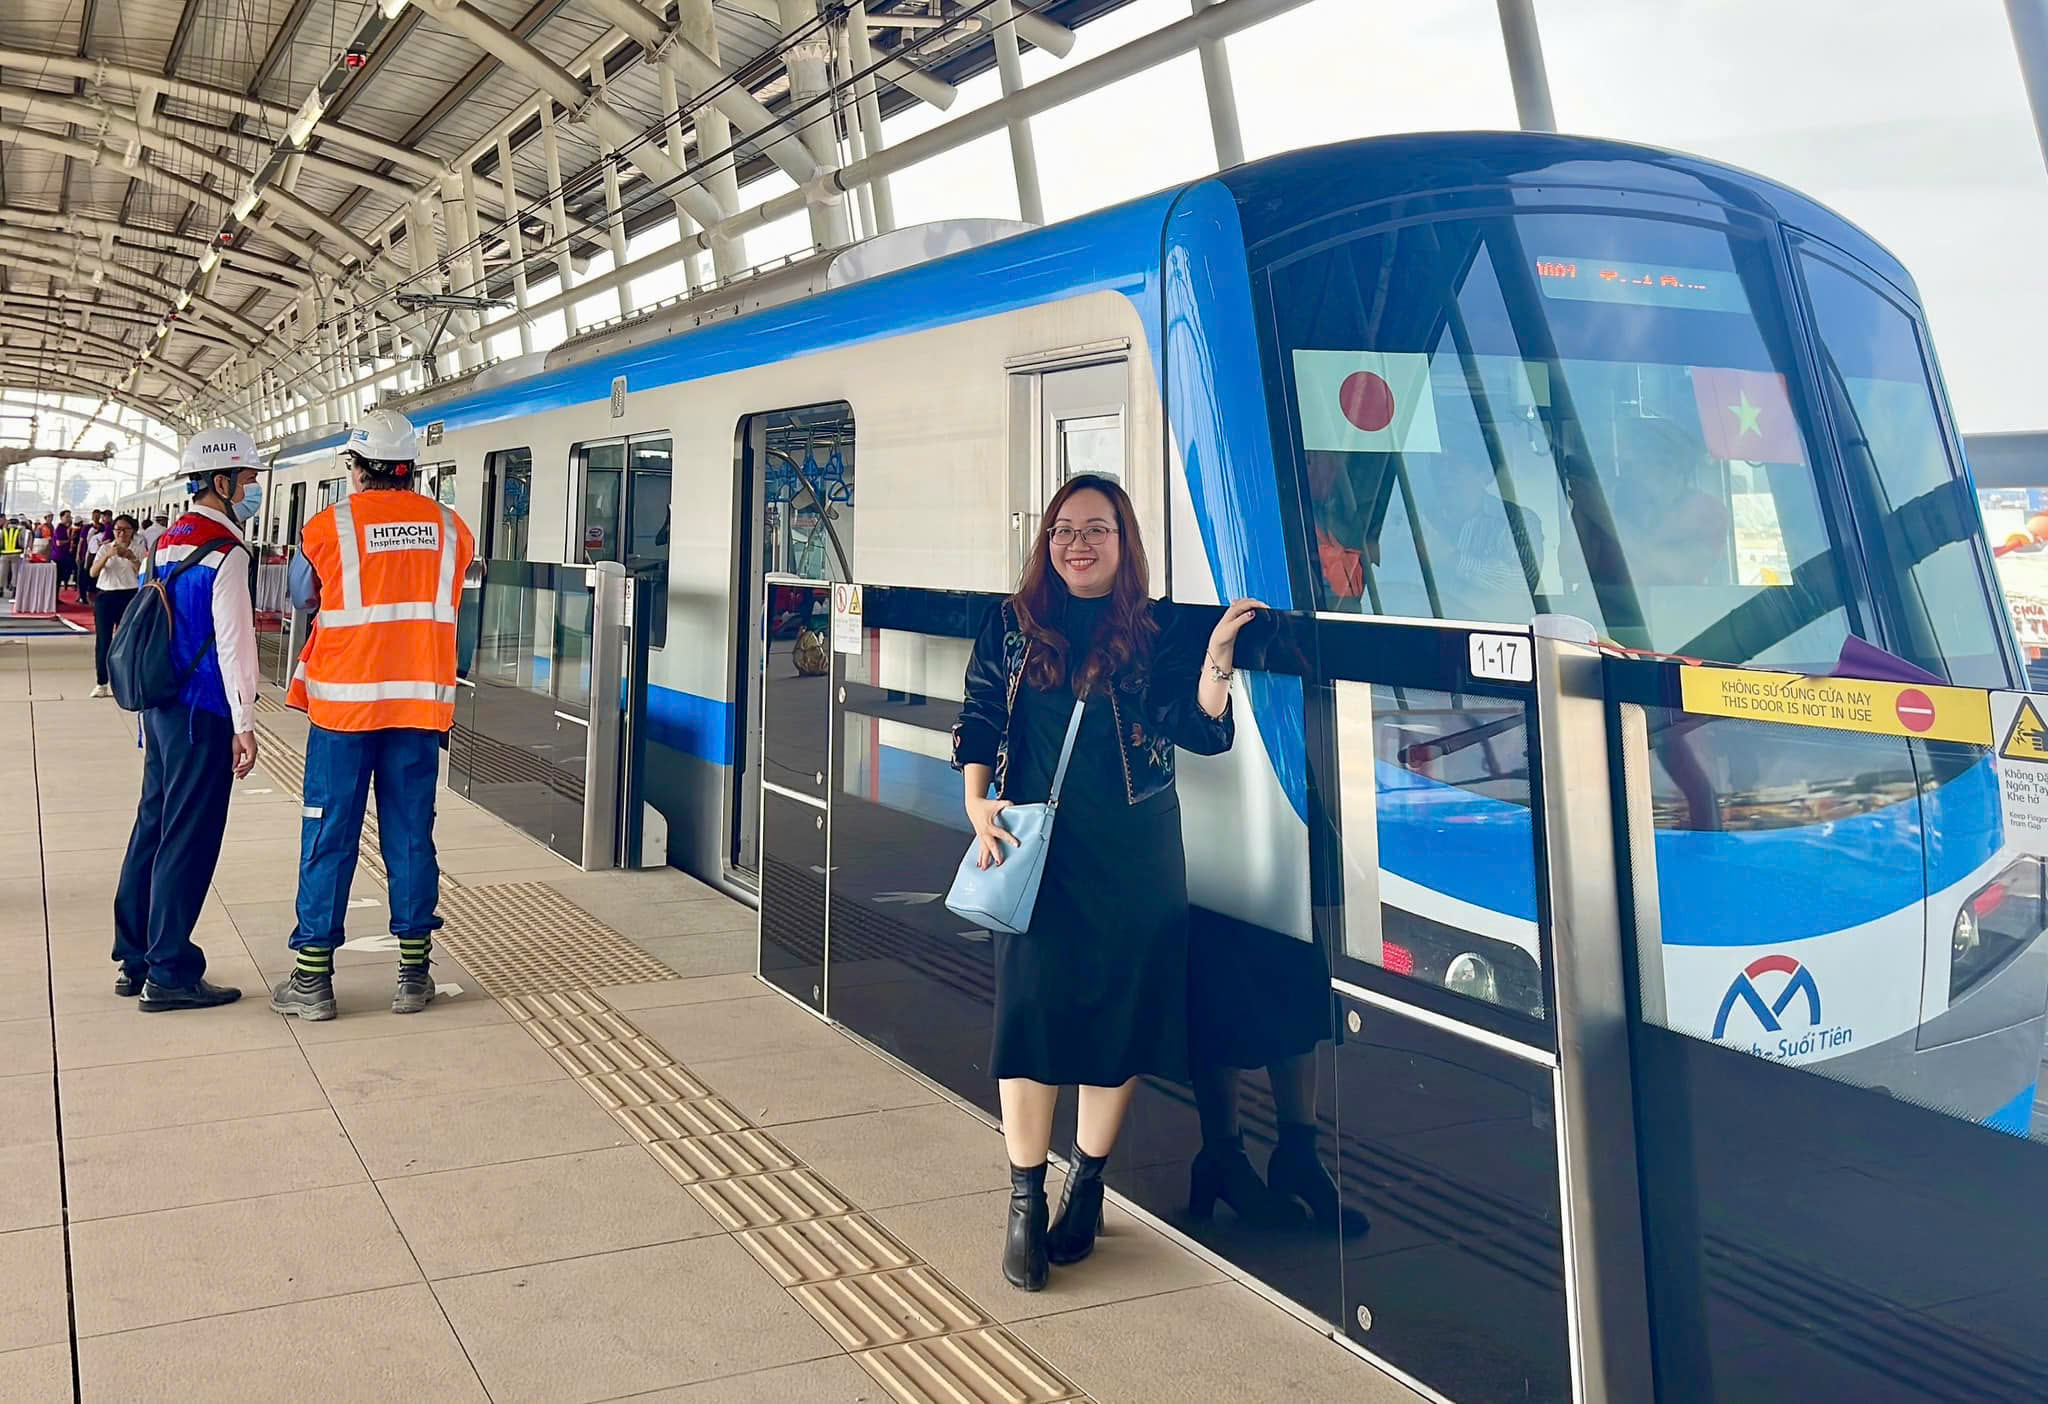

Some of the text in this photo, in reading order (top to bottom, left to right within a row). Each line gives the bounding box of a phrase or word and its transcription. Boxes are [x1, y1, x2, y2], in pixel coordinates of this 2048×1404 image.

[202, 443, 237, 454] MAUR
[373, 526, 433, 538] HITACHI
[370, 536, 436, 548] Inspire the Next
[1478, 640, 1517, 674] 1-17
[1721, 679, 1760, 695] KHÔNG
[1763, 681, 1780, 697] SỬ
[1818, 685, 1843, 703] CỬA
[1723, 695, 1873, 722] THIS DOOR IS NOT IN USE
[2005, 768, 2034, 783] Không
[2006, 780, 2031, 793] Ngón
[2007, 791, 2025, 803] Khe
[1779, 1031, 1816, 1058] Suối
[1818, 1026, 1853, 1050] Tiên
